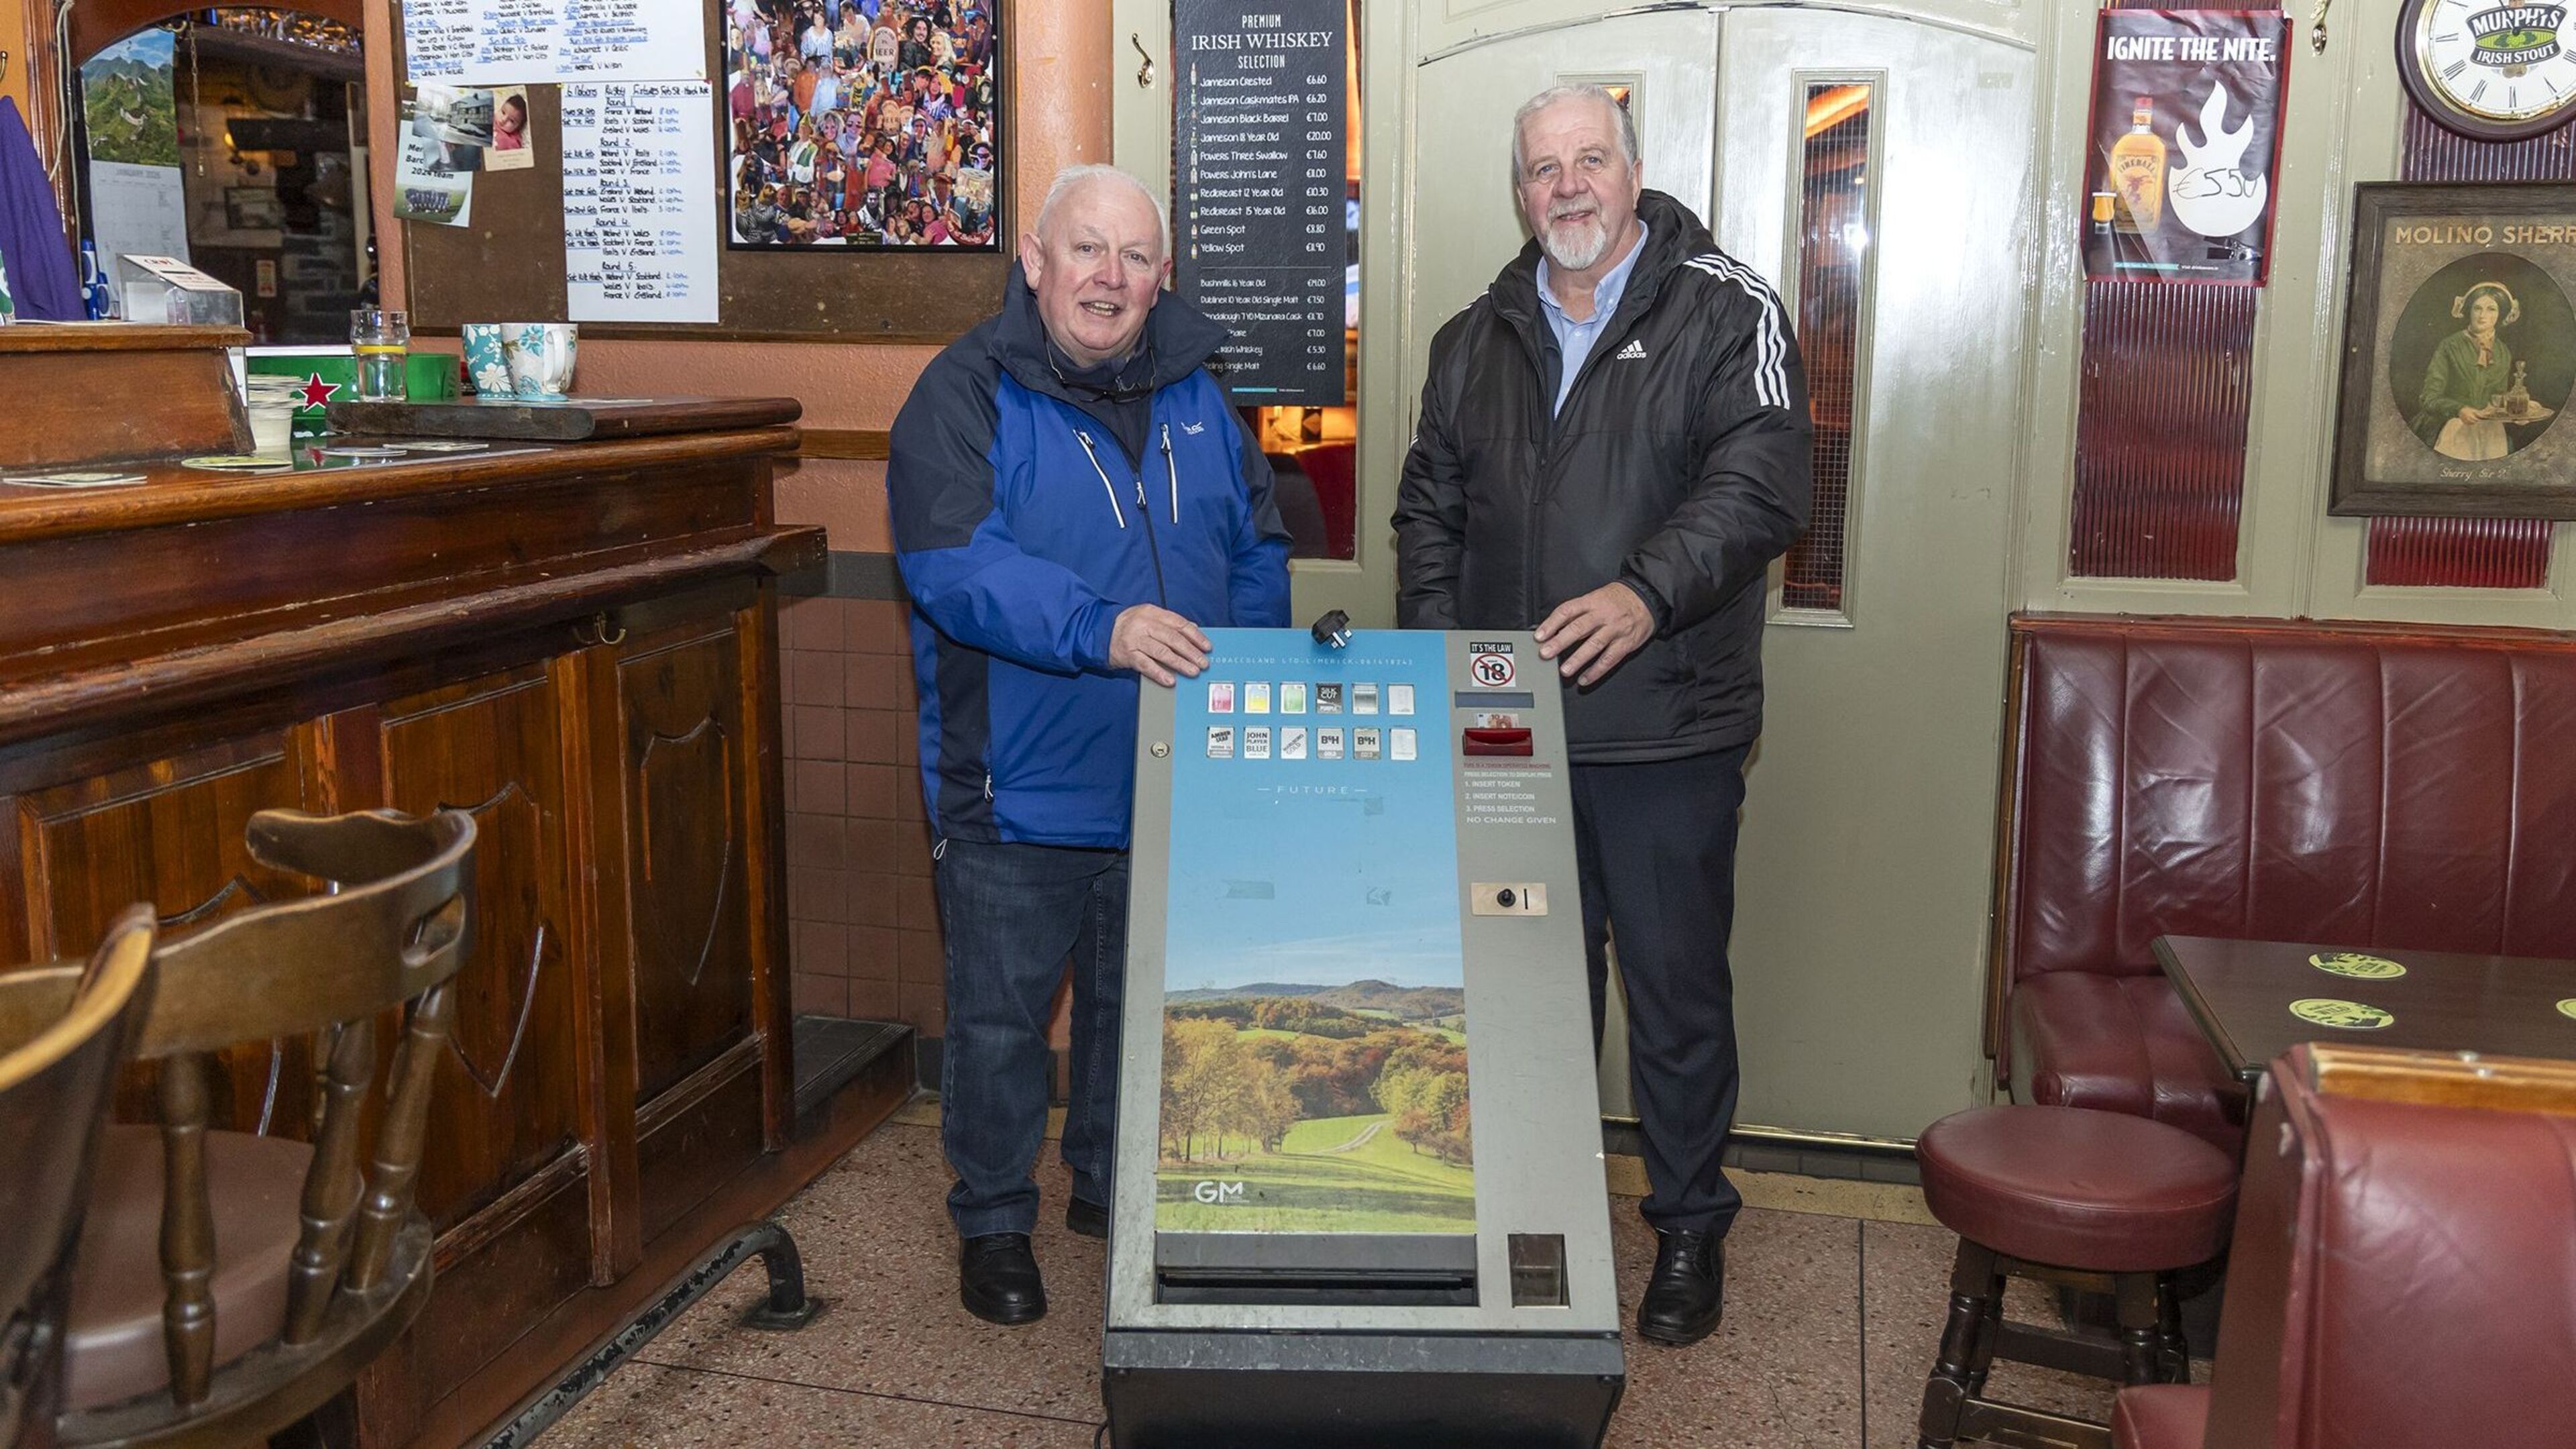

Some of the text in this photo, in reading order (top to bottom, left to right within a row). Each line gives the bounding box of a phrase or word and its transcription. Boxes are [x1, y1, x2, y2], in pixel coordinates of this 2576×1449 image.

[1242, 14, 1281, 28] PREMIUM
[2472, 8, 2561, 36] MURPHYS
[1192, 32, 1332, 50] IRISH WHISKEY
[2107, 36, 2276, 62] IGNITE THE NITE.
[2477, 44, 2554, 64] IRISH STOUT
[1238, 55, 1285, 68] SELECTION
[1200, 77, 1239, 87] Jameson
[1240, 76, 1272, 86] Crested
[1200, 97, 1239, 106] Jameson
[1240, 95, 1287, 105] Caskmates
[1200, 115, 1239, 125] Jameson
[1240, 113, 1263, 123] Black
[1263, 113, 1289, 123] Barrel
[1200, 134, 1239, 144] Jameson
[1246, 132, 1265, 142] Year
[1267, 131, 1279, 141] Old
[1200, 152, 1229, 161] Powers
[1231, 151, 1254, 160] Three
[1255, 150, 1288, 160] Swallow
[434, 170, 454, 180] team
[1200, 170, 1229, 180] Powers
[1258, 168, 1277, 178] Lane
[1200, 188, 1242, 198] Redbreast
[1250, 187, 1270, 197] Year
[1271, 187, 1283, 197] Old
[1200, 206, 1242, 216] Redbreast
[1253, 206, 1272, 215] Year
[1273, 205, 1285, 215] Old
[1200, 225, 1226, 234] Green
[1226, 225, 1245, 236] Spot
[2395, 225, 2493, 244] MOLINO
[1200, 244, 1224, 252] Yellow
[1225, 243, 1244, 254] Spot
[1200, 278, 1232, 287] Bushmills
[1238, 278, 1254, 287] Year
[1255, 278, 1266, 287] Old
[1200, 296, 1227, 304] Dubliner
[1235, 296, 1251, 304] Year
[1252, 295, 1263, 303] Old
[1263, 296, 1282, 307] Single
[1283, 295, 1298, 303] Malt
[1285, 313, 1302, 321] Cask
[1236, 345, 1263, 356] Whiskey
[1617, 351, 1647, 360] adidas
[1244, 362, 1260, 370] Malt
[1484, 644, 1497, 653] THE
[1497, 644, 1511, 653] LAW
[1480, 663, 1505, 681] 18
[1277, 786, 1349, 794] FUTURE
[1195, 1181, 1242, 1203] GM
